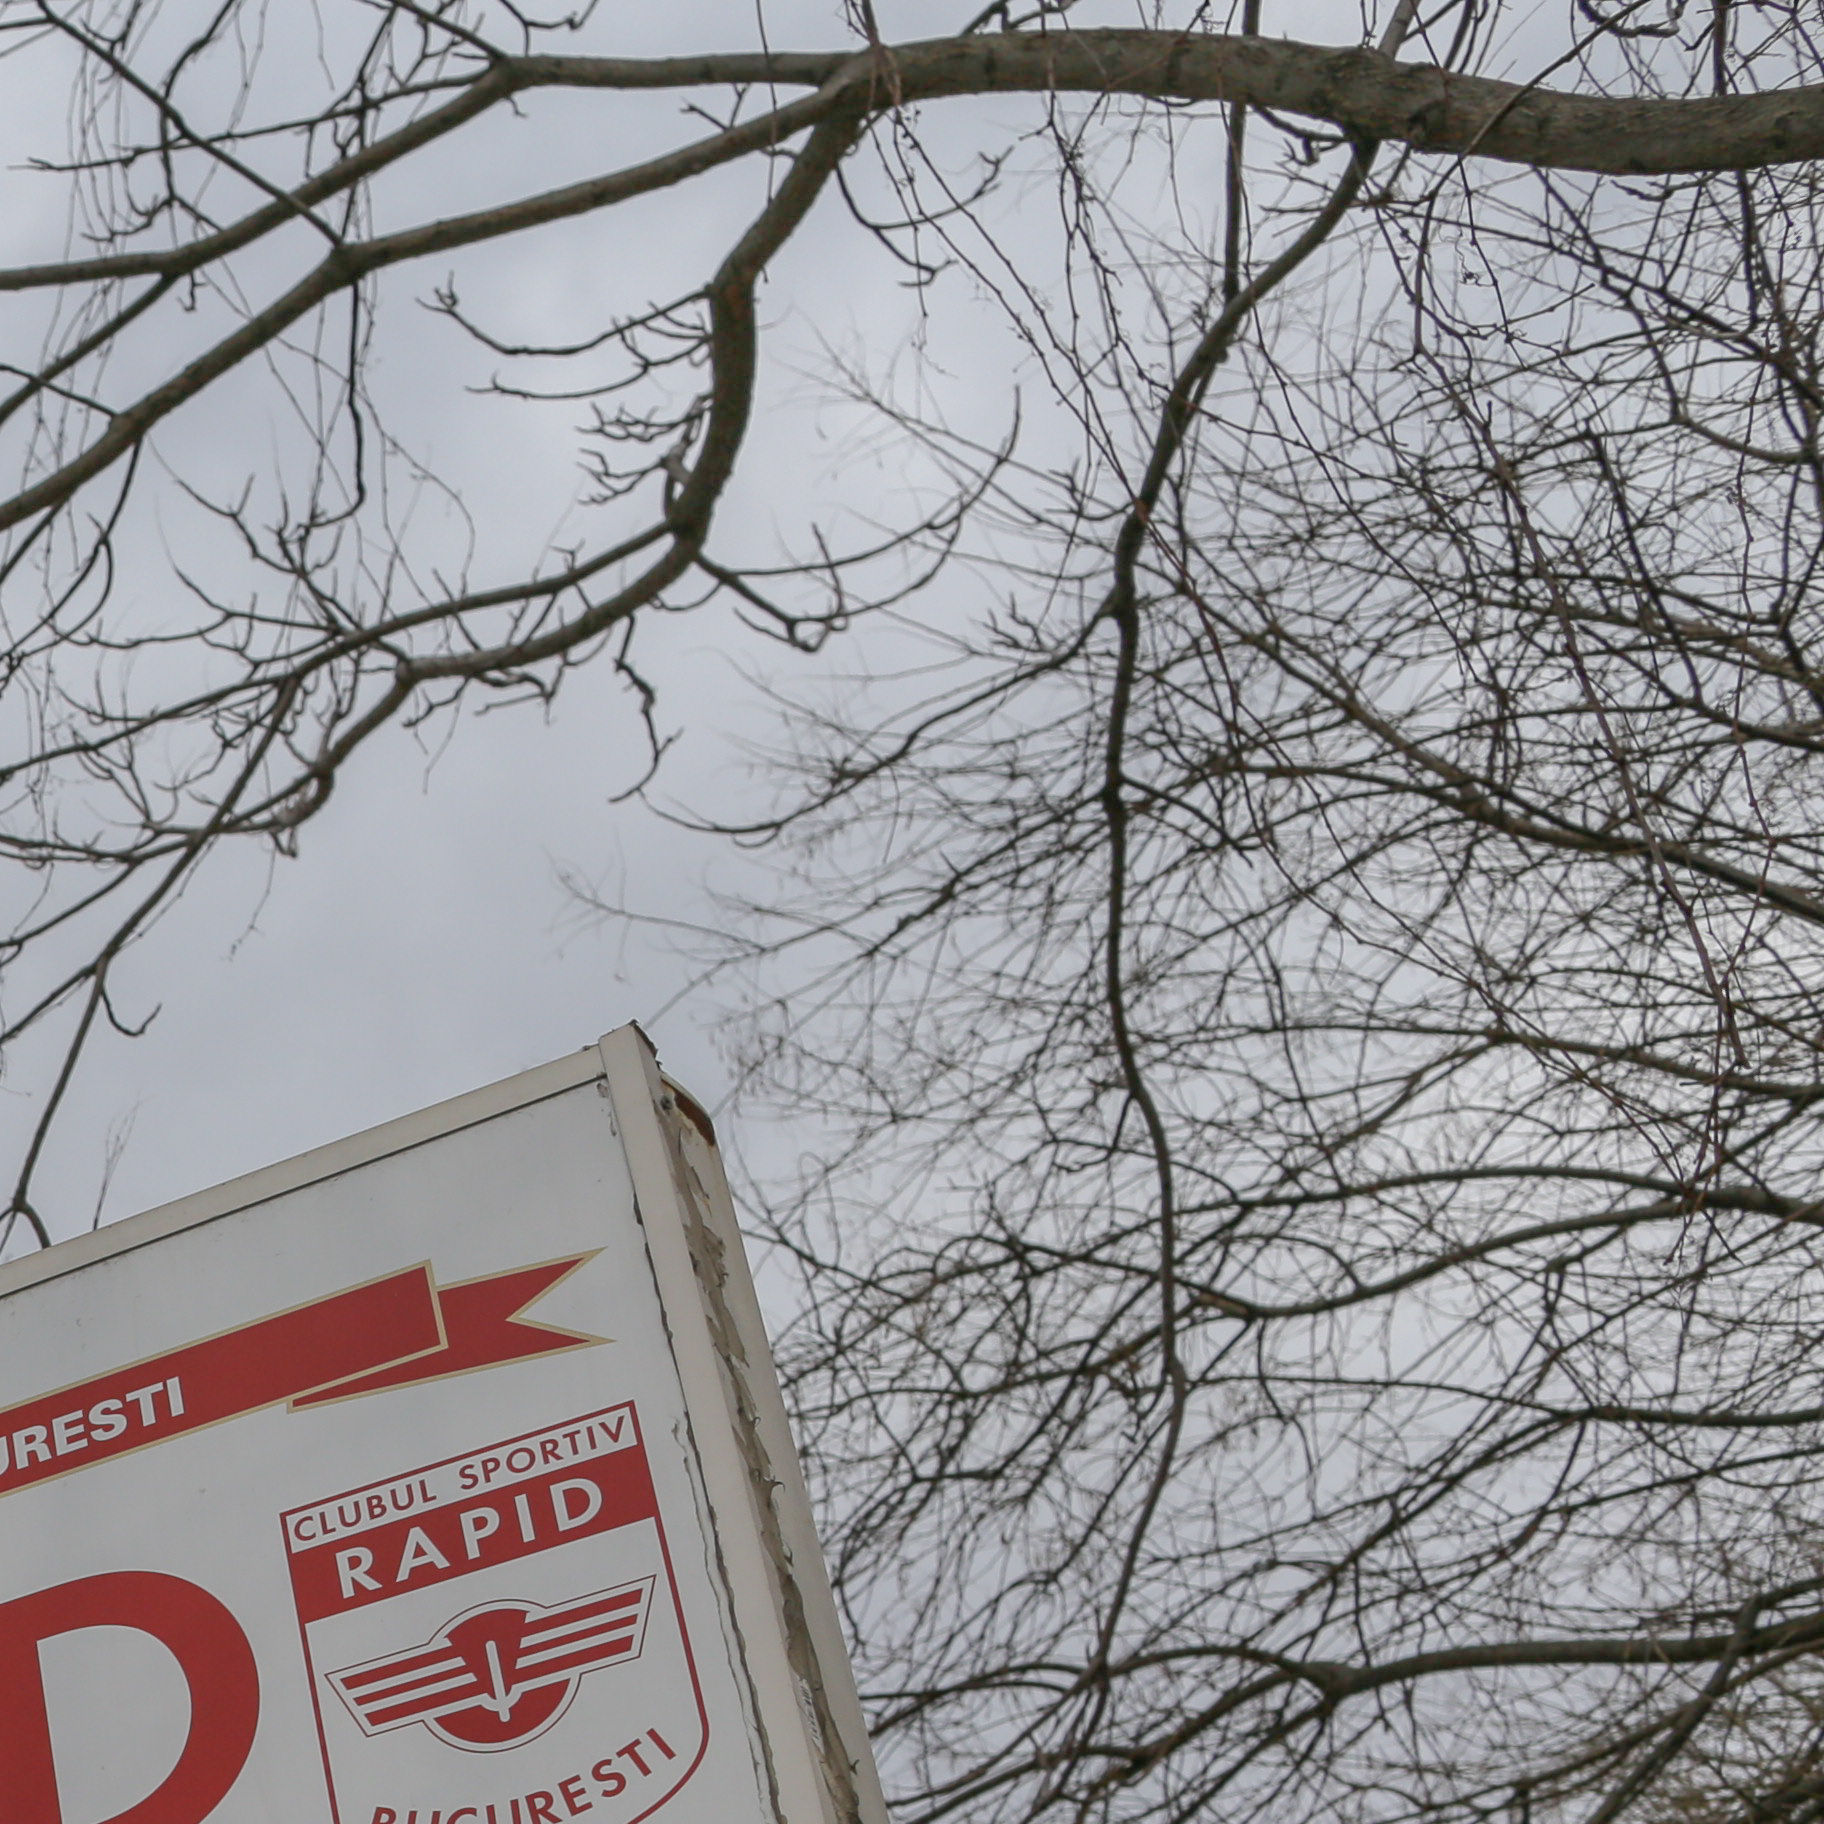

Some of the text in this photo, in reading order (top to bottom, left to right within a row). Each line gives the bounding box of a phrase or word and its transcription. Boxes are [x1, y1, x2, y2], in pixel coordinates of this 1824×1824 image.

[293, 1414, 625, 1542] CLUBUL SPORTIV
[334, 1477, 604, 1600] RAPID
